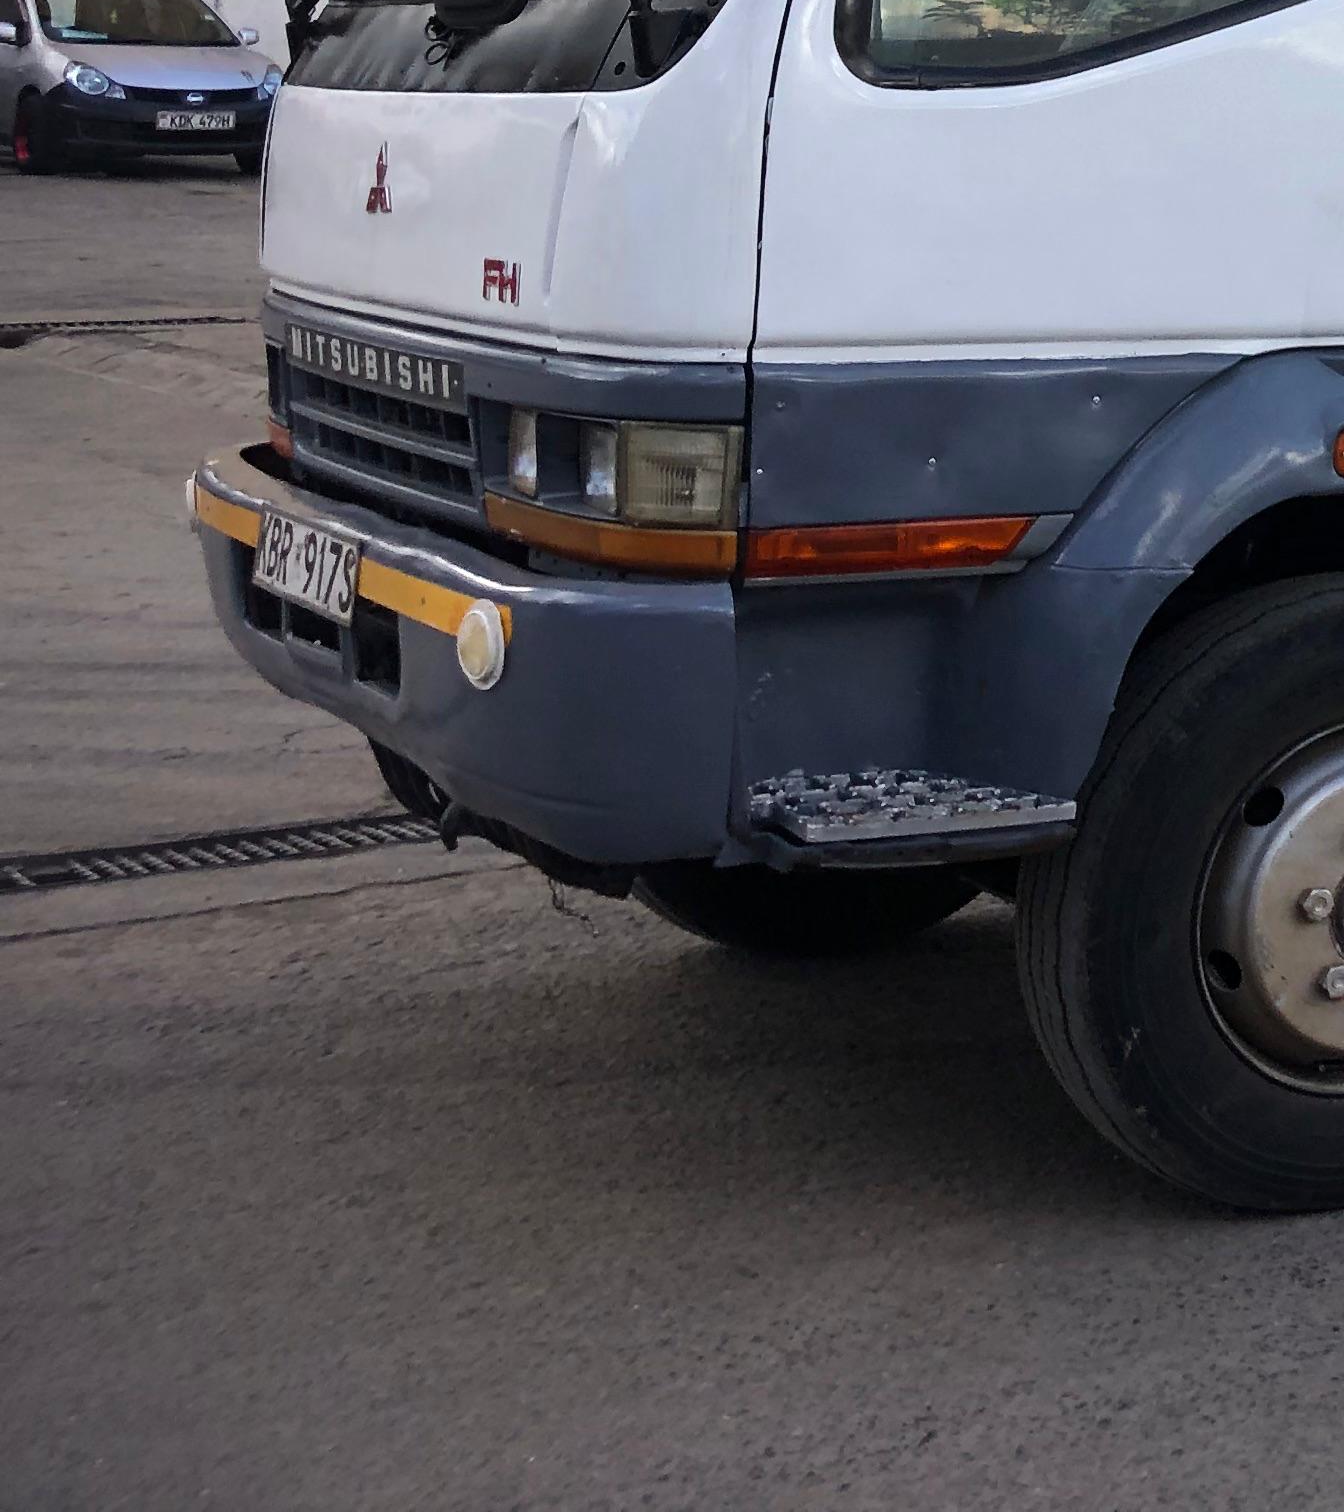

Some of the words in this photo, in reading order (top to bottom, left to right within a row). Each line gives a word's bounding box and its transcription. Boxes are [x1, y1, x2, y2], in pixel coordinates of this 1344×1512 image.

[170, 115, 194, 128] KDK
[291, 327, 450, 399] MITSUBISHI
[261, 511, 294, 586] KBR
[302, 531, 356, 614] 917S
